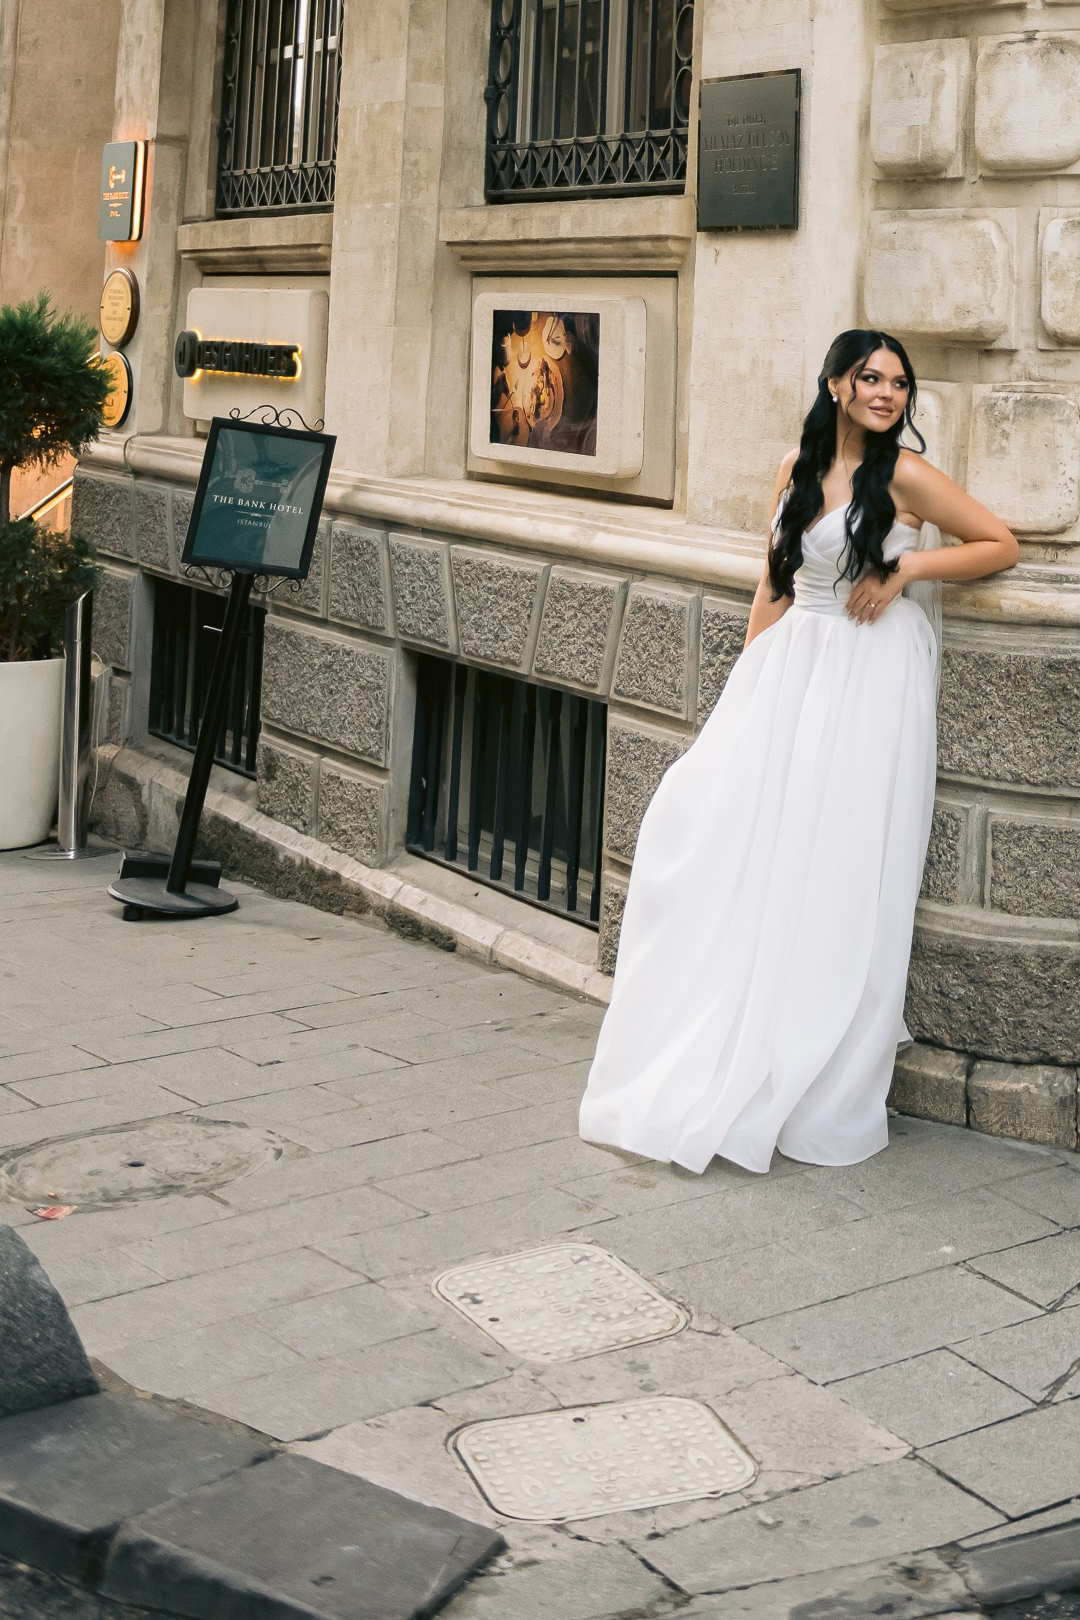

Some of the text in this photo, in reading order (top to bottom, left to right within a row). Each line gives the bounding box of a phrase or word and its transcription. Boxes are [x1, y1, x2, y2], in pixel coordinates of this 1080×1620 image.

[213, 494, 304, 515] THE BANK HOTEL
